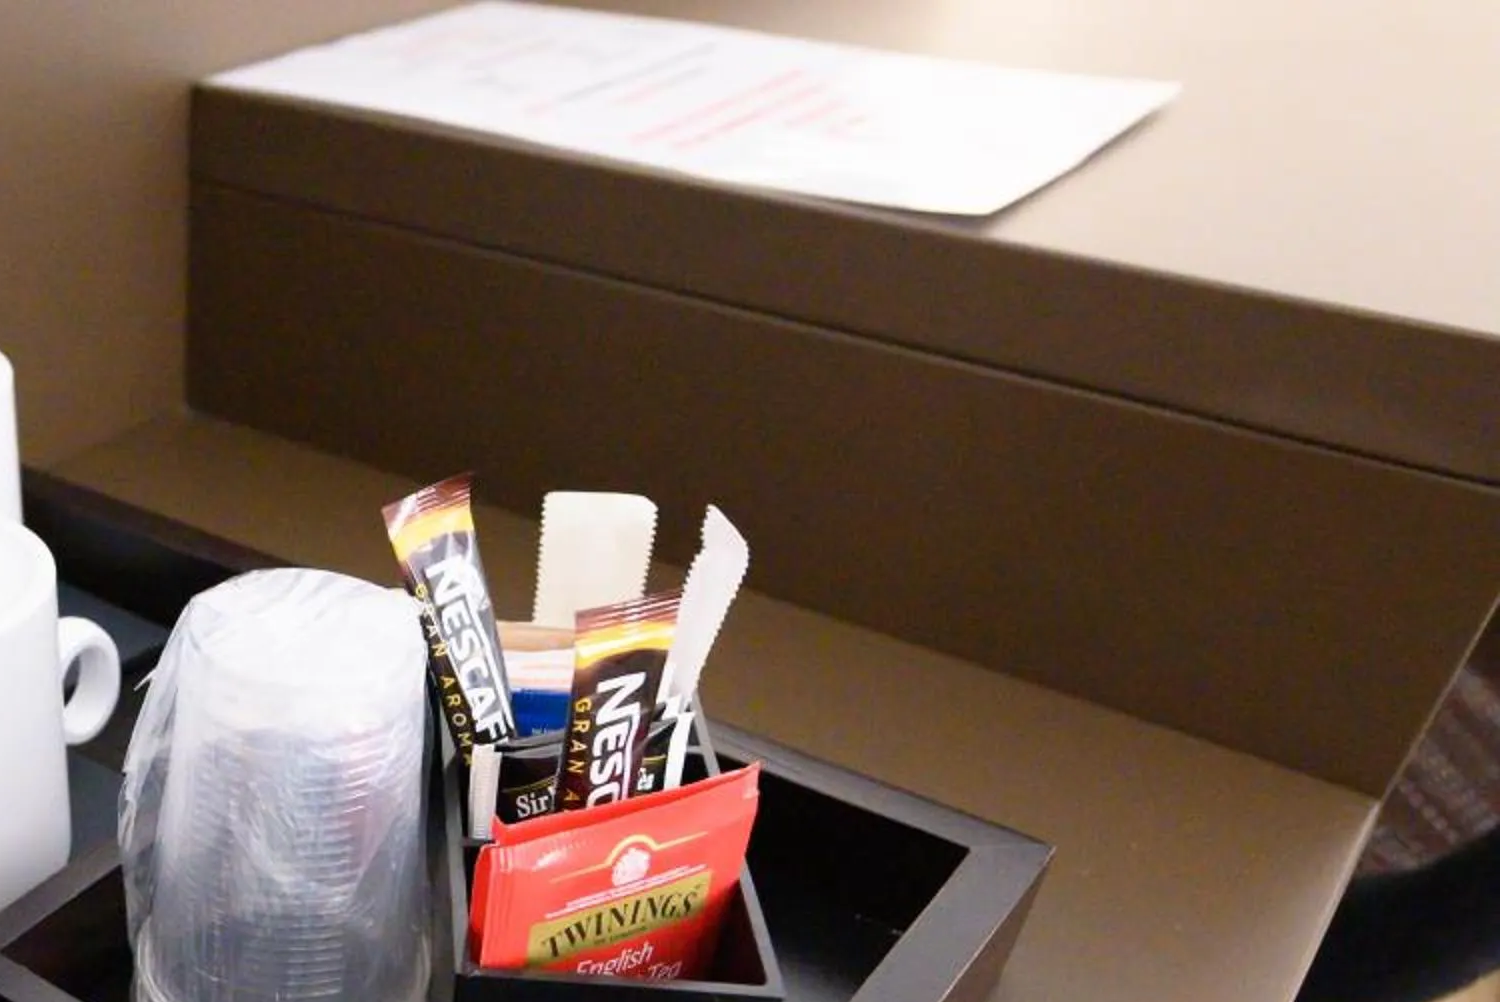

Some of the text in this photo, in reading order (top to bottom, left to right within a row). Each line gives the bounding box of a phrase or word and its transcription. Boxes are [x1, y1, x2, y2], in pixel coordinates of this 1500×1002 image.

[567, 697, 592, 774] GRAN
[542, 891, 698, 957] TWININGS
[576, 942, 654, 976] English
